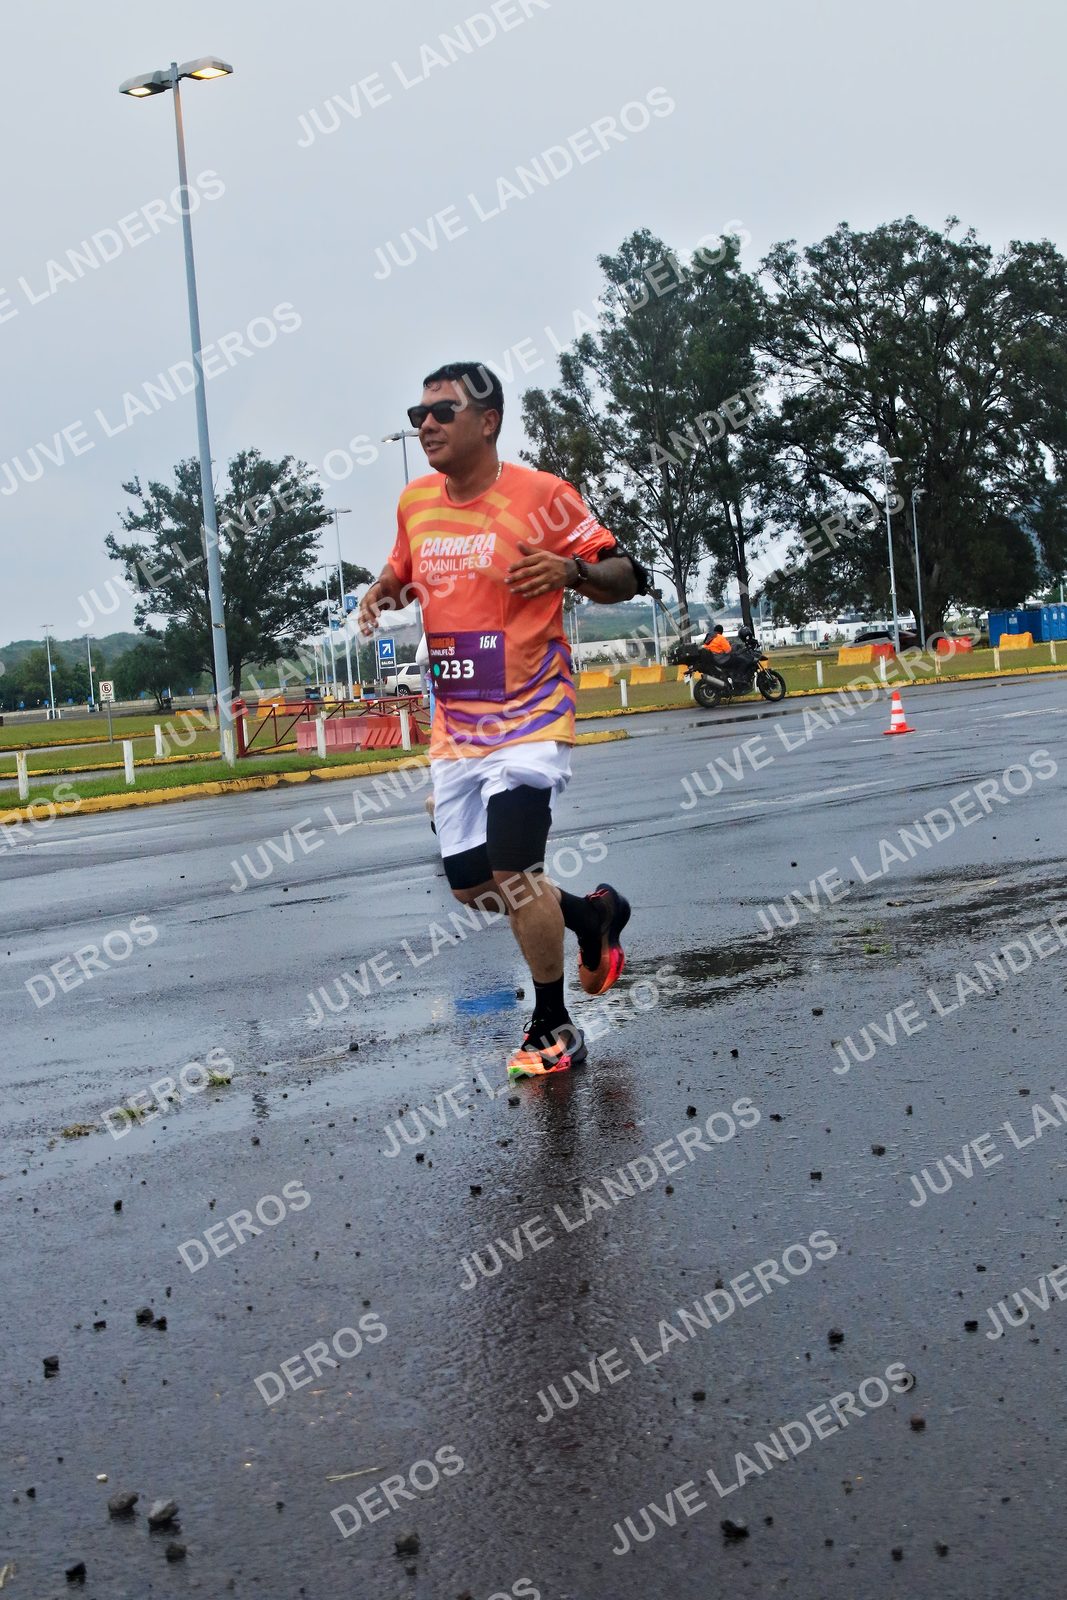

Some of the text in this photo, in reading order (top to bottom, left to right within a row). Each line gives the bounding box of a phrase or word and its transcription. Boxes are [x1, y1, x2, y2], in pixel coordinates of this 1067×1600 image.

[420, 533, 497, 558] CARRERA
[419, 556, 475, 573] OMNILIFE
[440, 659, 475, 680] 233
